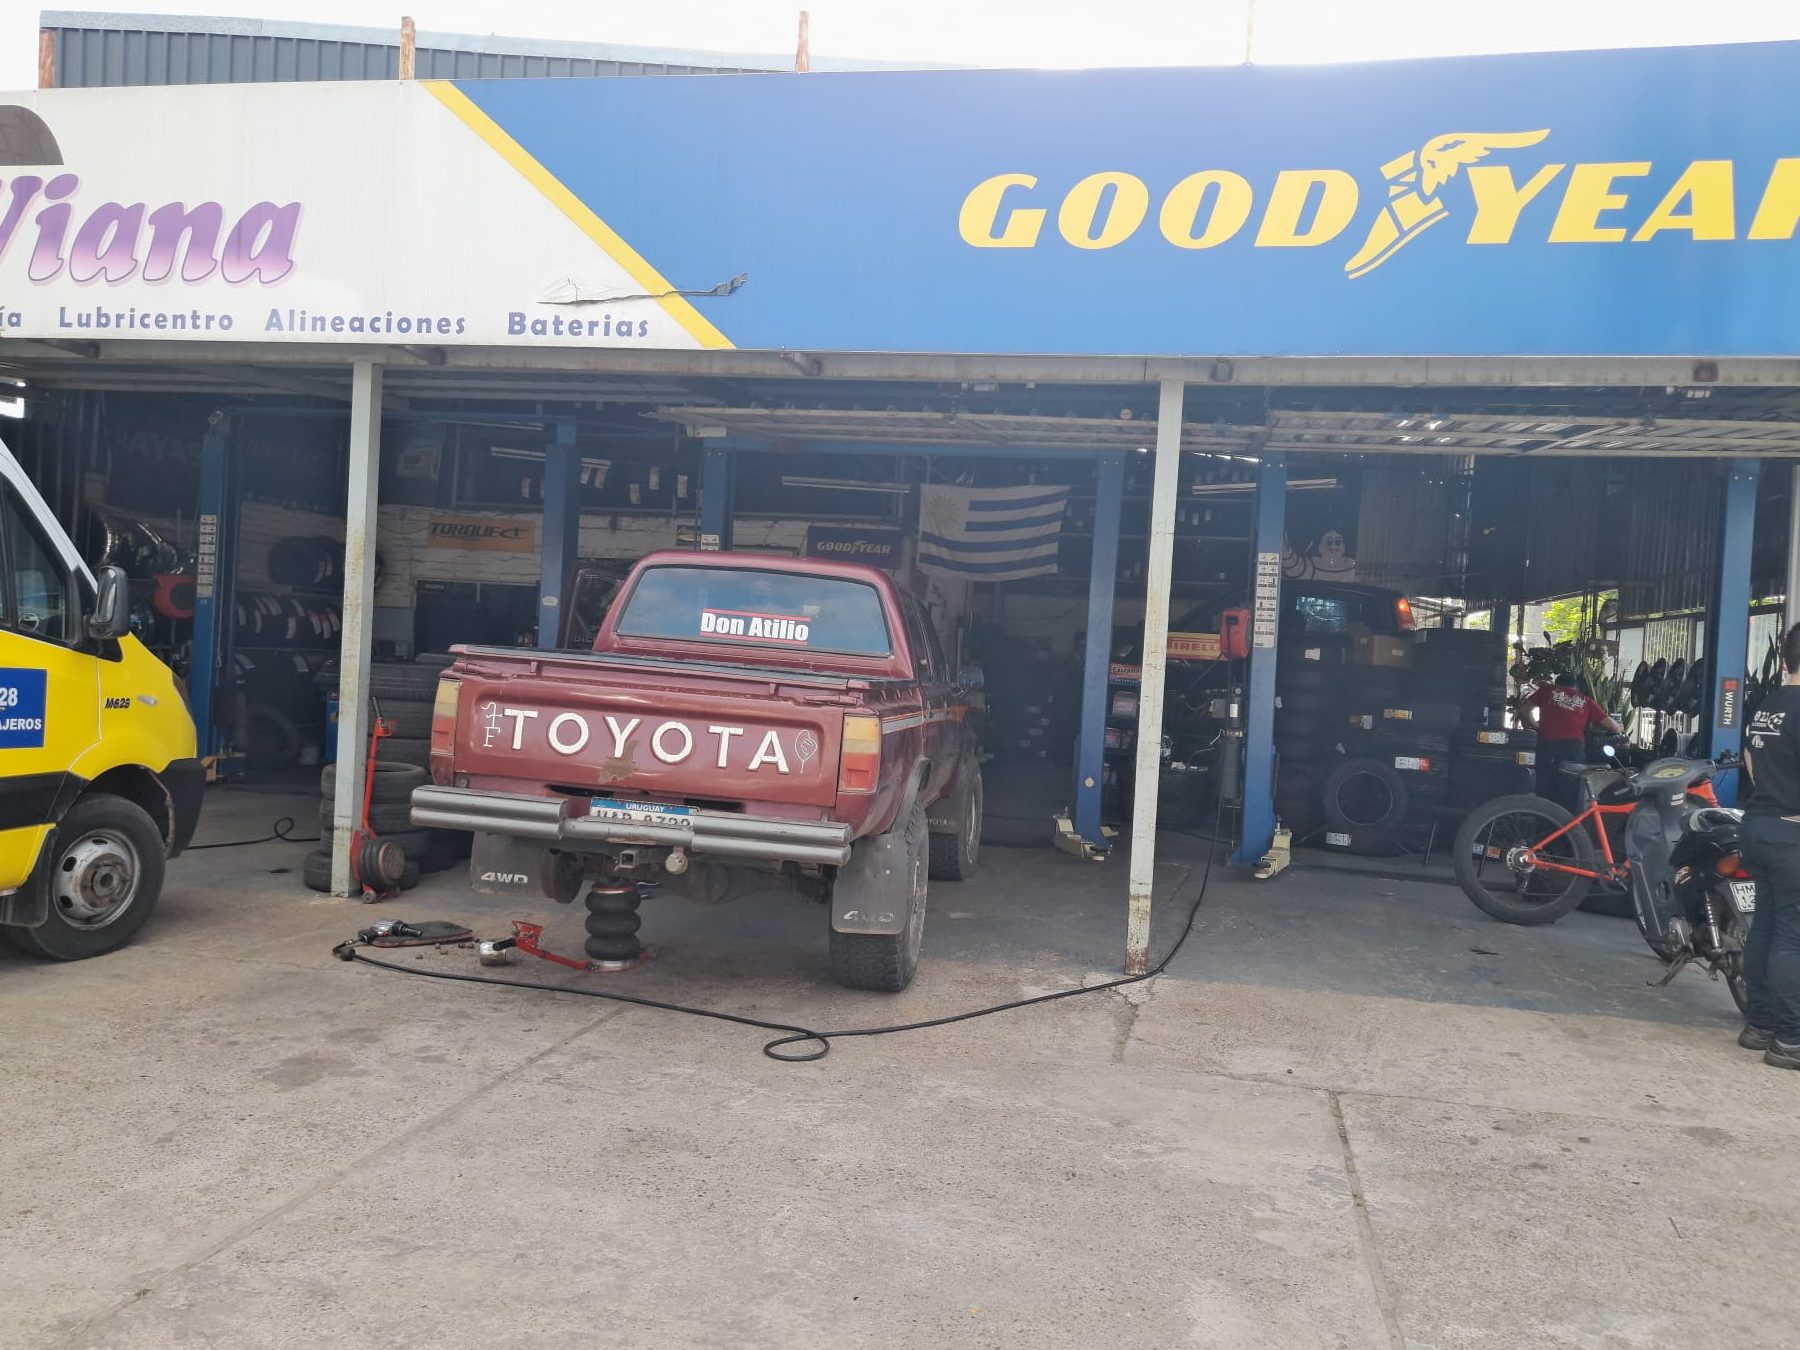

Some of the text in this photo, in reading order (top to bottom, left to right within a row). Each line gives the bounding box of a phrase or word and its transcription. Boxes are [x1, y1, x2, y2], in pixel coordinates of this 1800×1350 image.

[59, 306, 233, 330] Lubricentro
[265, 308, 466, 335] Alineaciones
[508, 312, 649, 338] Baterias
[817, 541, 892, 554] GOODYEAR
[700, 612, 809, 641] Don Atilio
[1167, 637, 1220, 652] IRELL
[503, 707, 790, 775] TOYOTA
[625, 803, 665, 813] URUGUAY
[480, 871, 529, 884] 4WD
